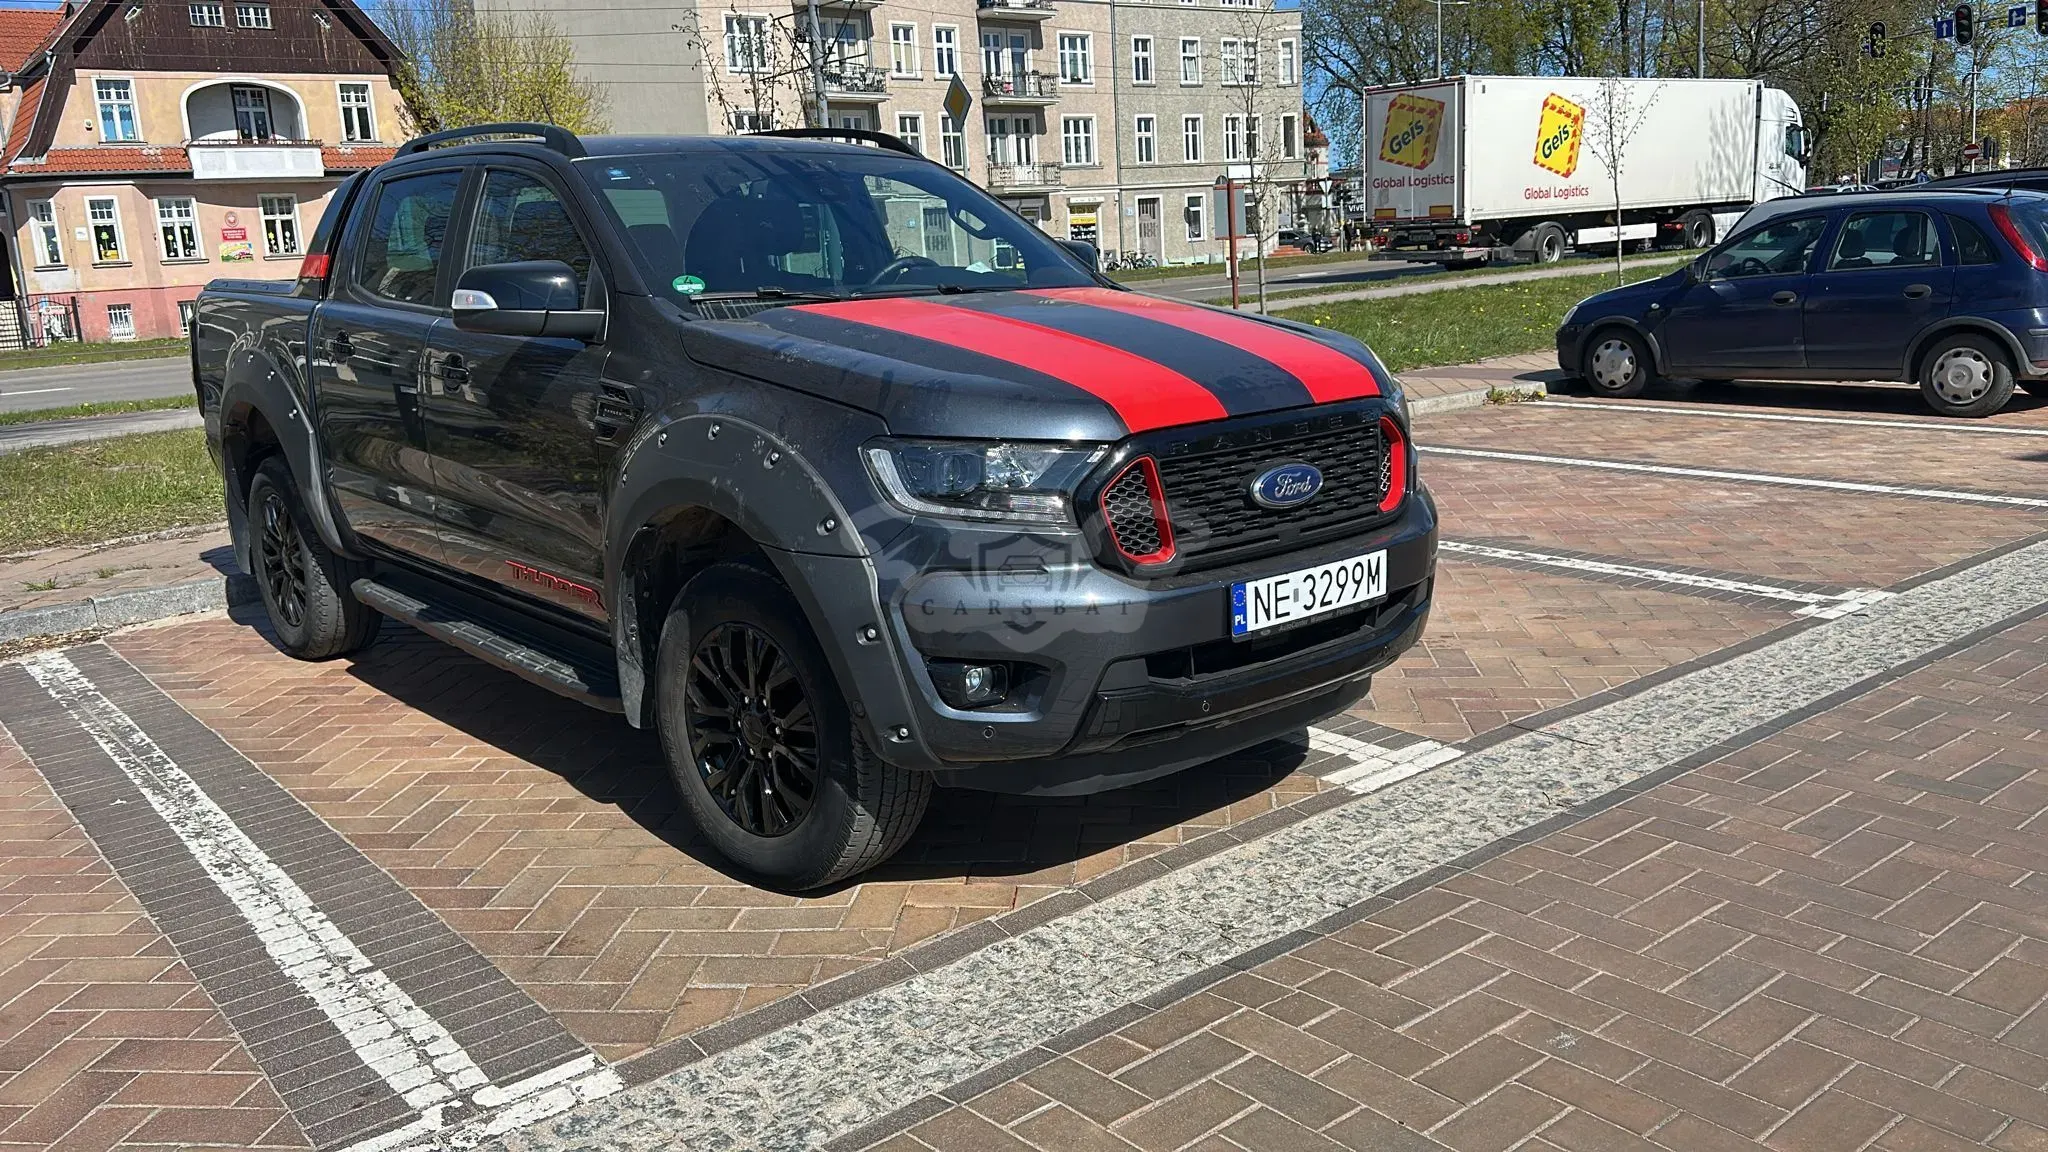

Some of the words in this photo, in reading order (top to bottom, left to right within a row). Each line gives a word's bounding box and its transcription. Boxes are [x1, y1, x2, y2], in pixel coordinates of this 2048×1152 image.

[1389, 118, 1425, 155] Geis
[1541, 123, 1570, 159] Geis
[1372, 176, 1405, 189] Global
[1408, 173, 1455, 188] Logistics
[1524, 187, 1551, 200] Global
[1553, 185, 1589, 200] Logistics
[1274, 472, 1313, 498] Ford
[1254, 578, 1291, 624] NE
[1303, 556, 1381, 611] 3299M
[1234, 613, 1246, 626] PL
